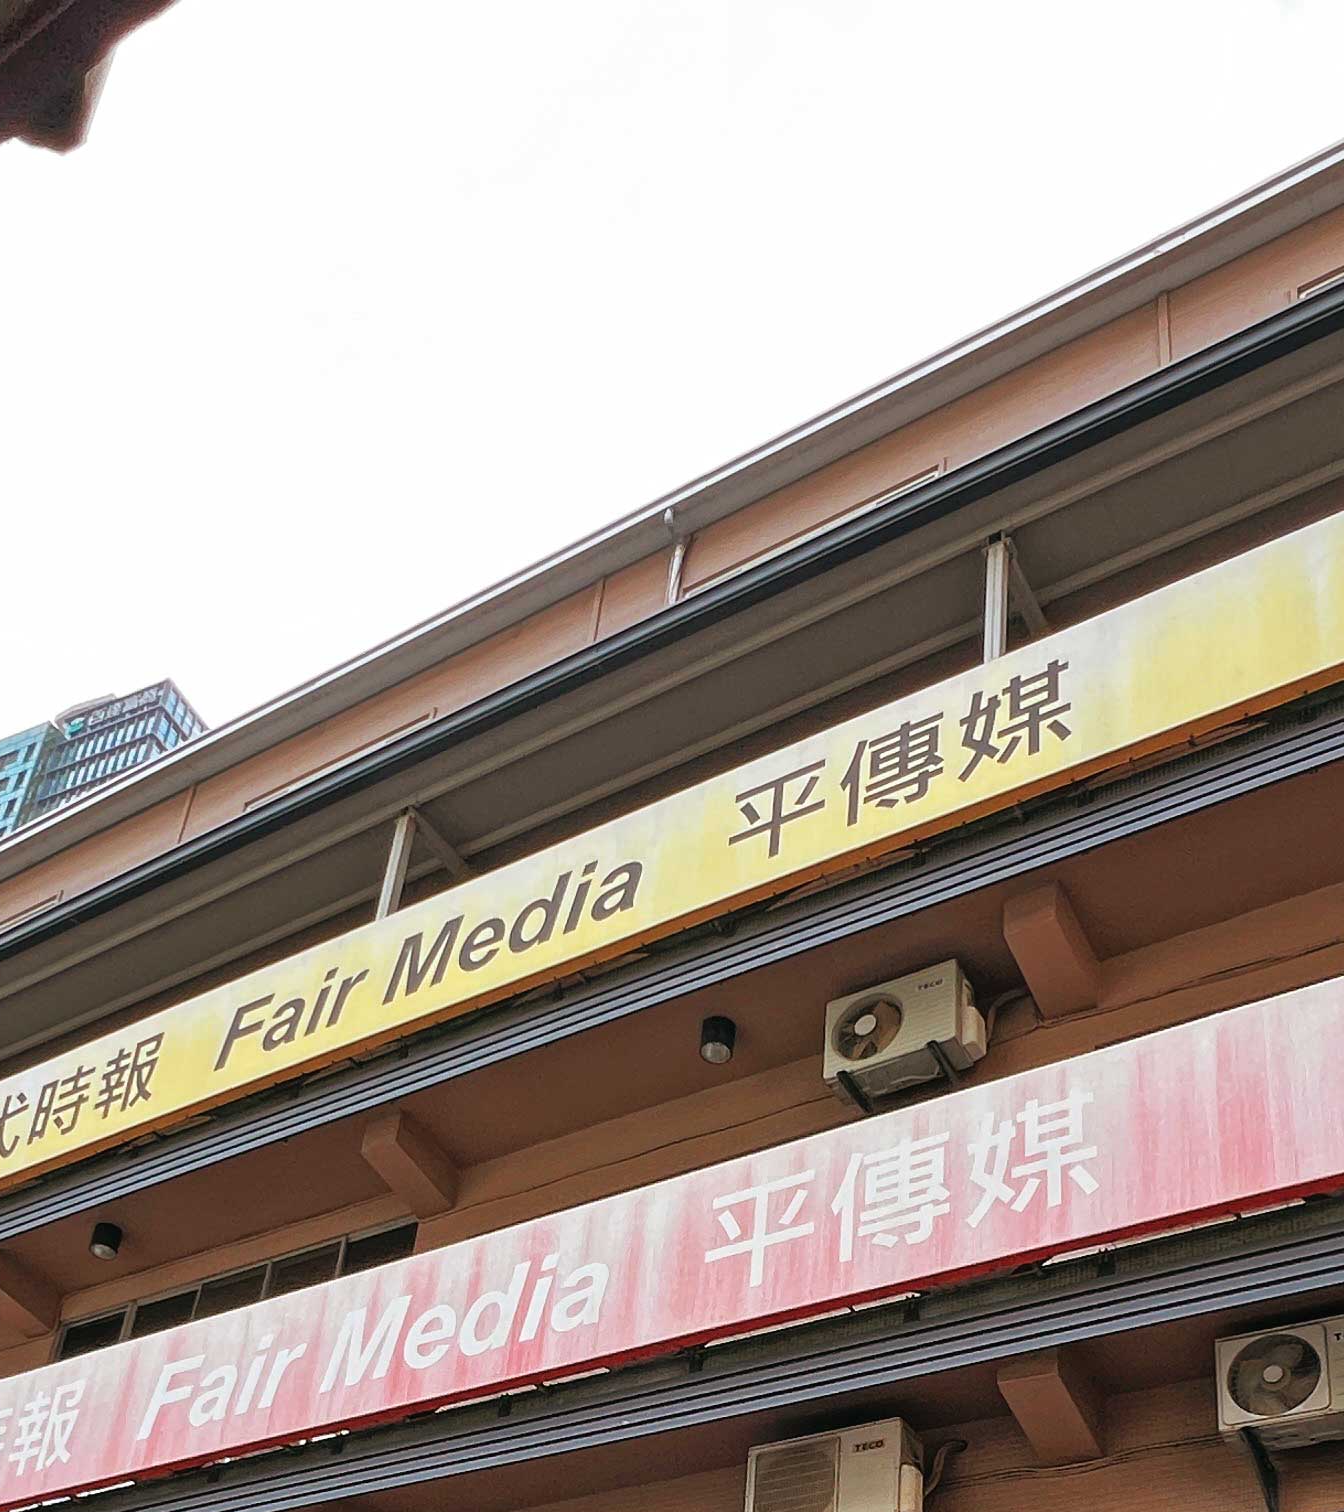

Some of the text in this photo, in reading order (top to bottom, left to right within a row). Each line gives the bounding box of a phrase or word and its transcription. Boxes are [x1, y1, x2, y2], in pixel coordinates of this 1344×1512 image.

[214, 966, 368, 1072] Fair
[383, 857, 644, 1006] Media
[726, 660, 1073, 859] 平傳媒
[136, 1334, 309, 1441] Fair
[319, 1254, 610, 1395] Media
[703, 1089, 1102, 1289] 平傳媒
